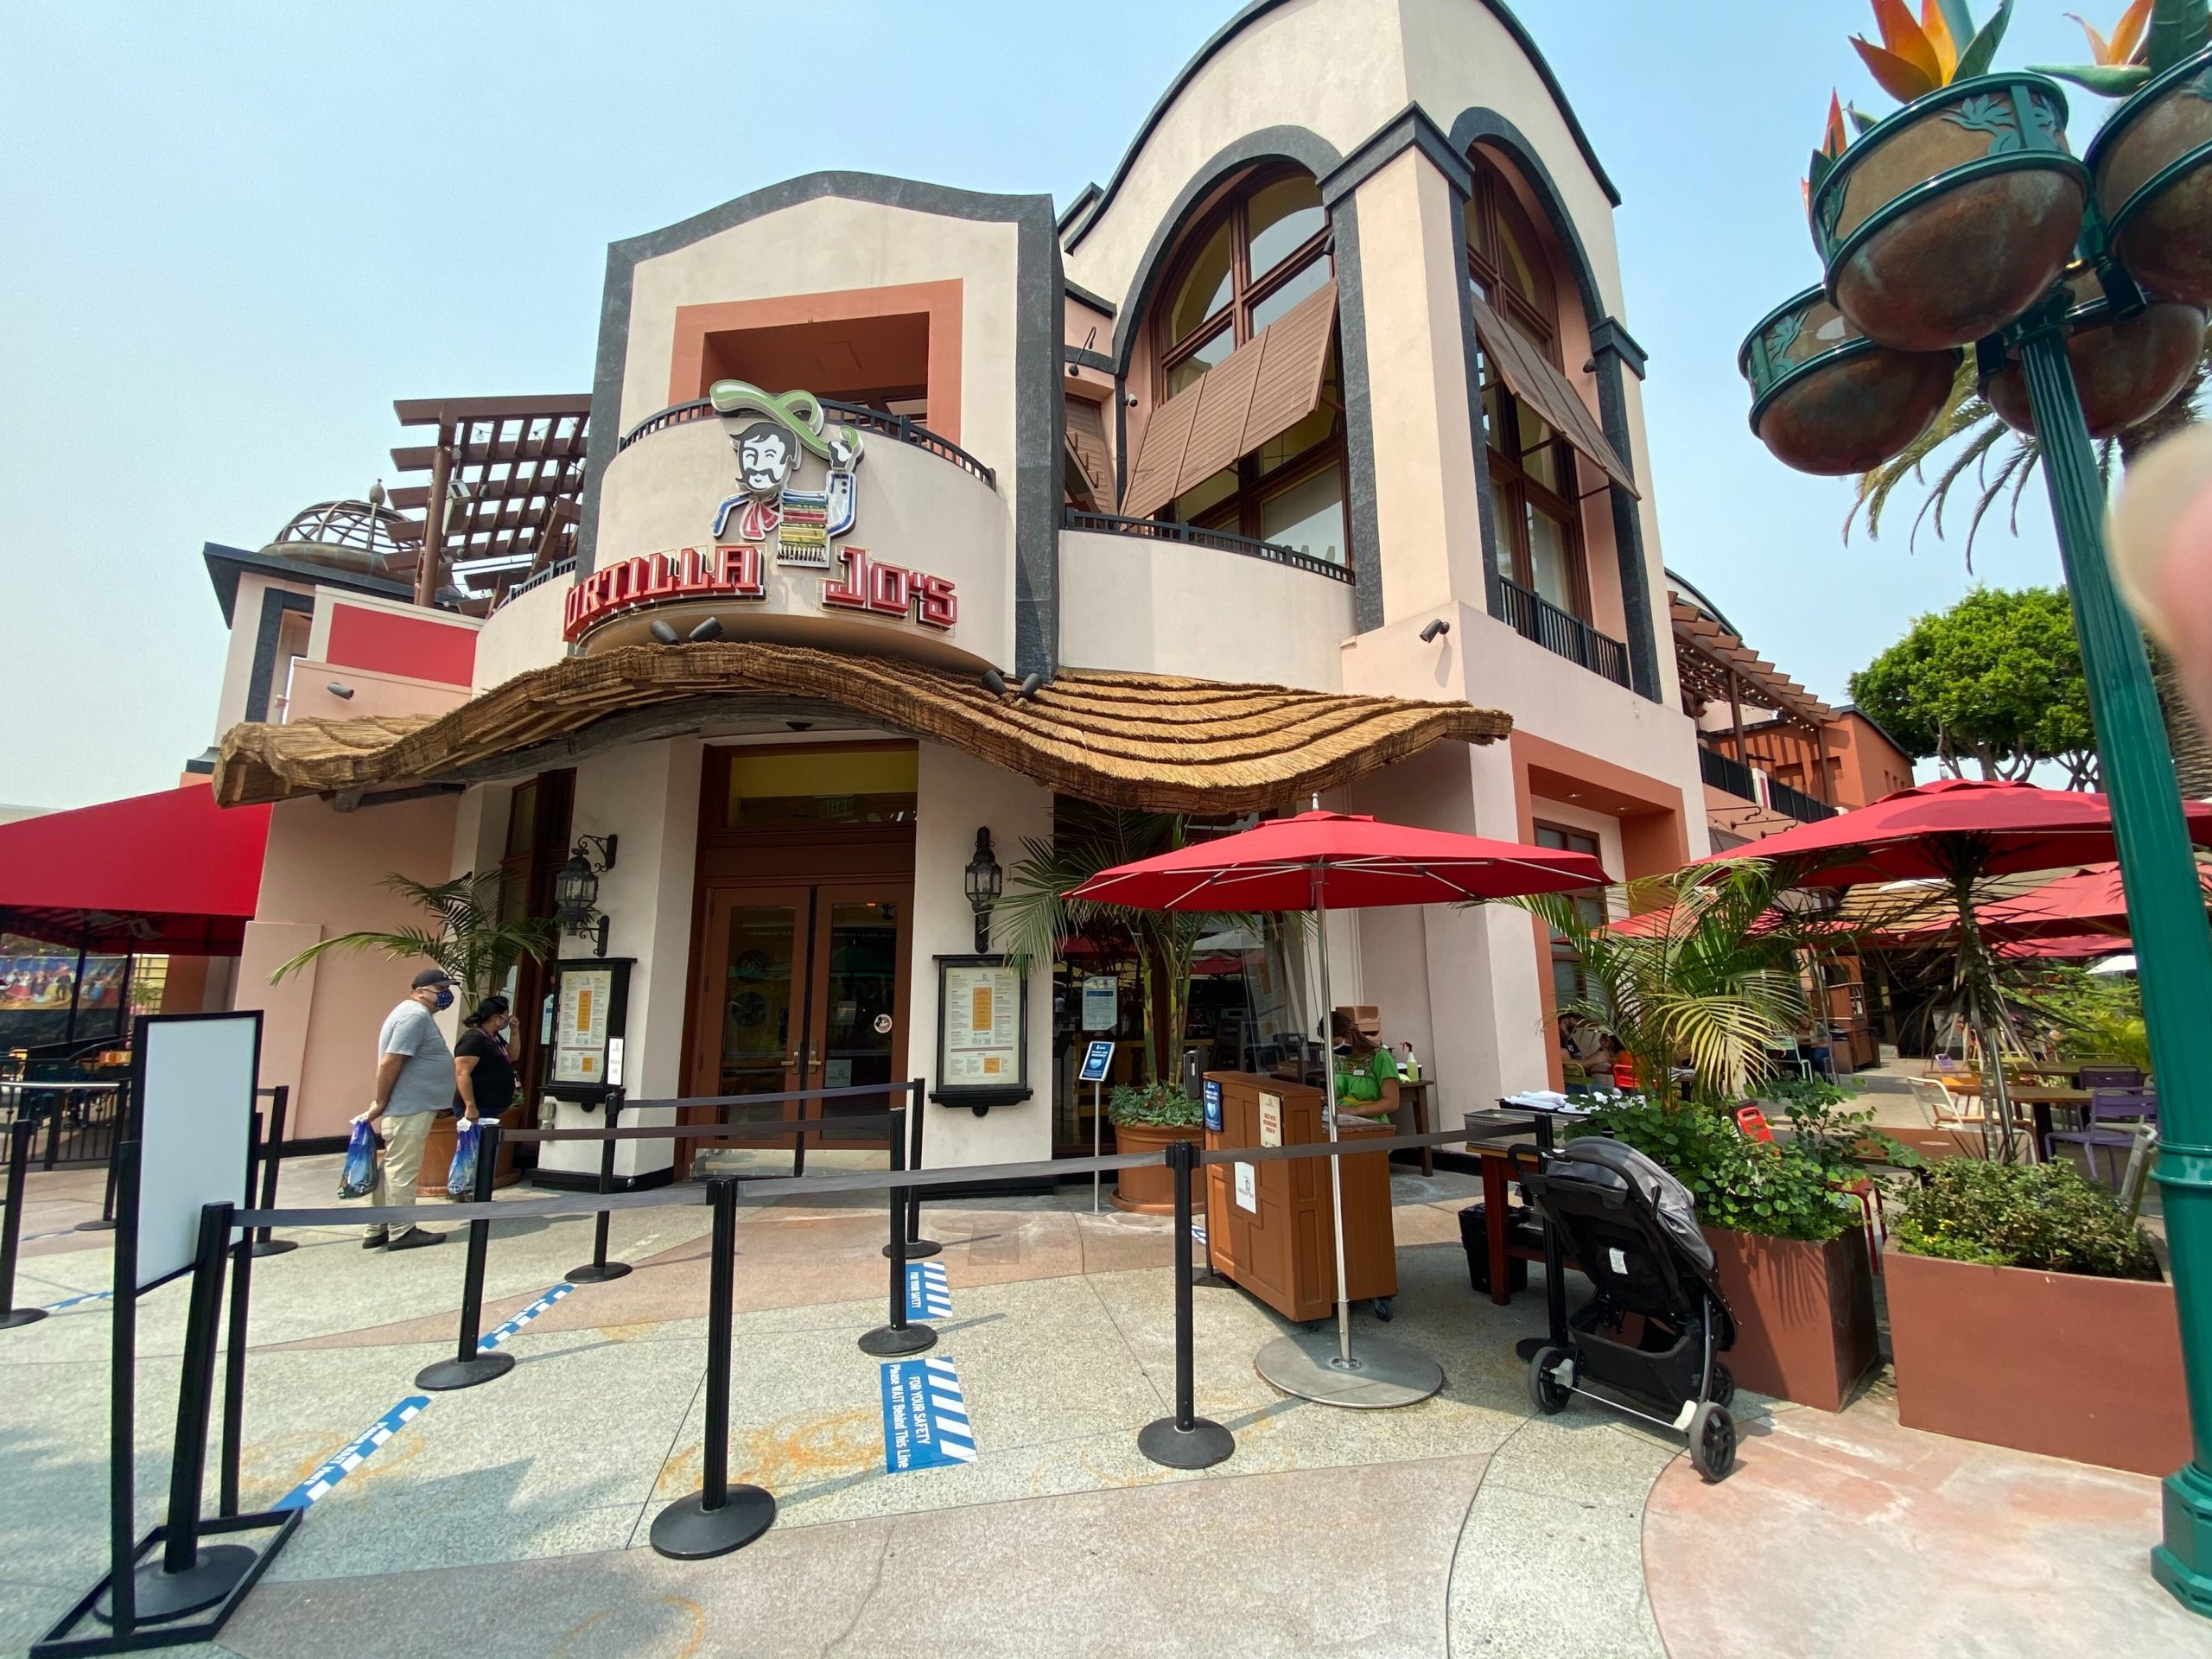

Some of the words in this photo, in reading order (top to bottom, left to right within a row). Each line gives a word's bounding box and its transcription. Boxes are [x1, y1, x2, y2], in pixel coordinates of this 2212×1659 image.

[563, 545, 765, 642] ORTILLA
[823, 546, 957, 626] JO'S
[911, 1291, 922, 1308] SAFETY
[889, 1363, 901, 1385] Please
[907, 1376, 921, 1391] FOR
[891, 1385, 905, 1403] WAIT
[911, 1391, 925, 1412] YOUR
[893, 1404, 908, 1430] Behind
[895, 1430, 910, 1448] This
[913, 1413, 931, 1445] SAFETY
[897, 1449, 912, 1469] Line
